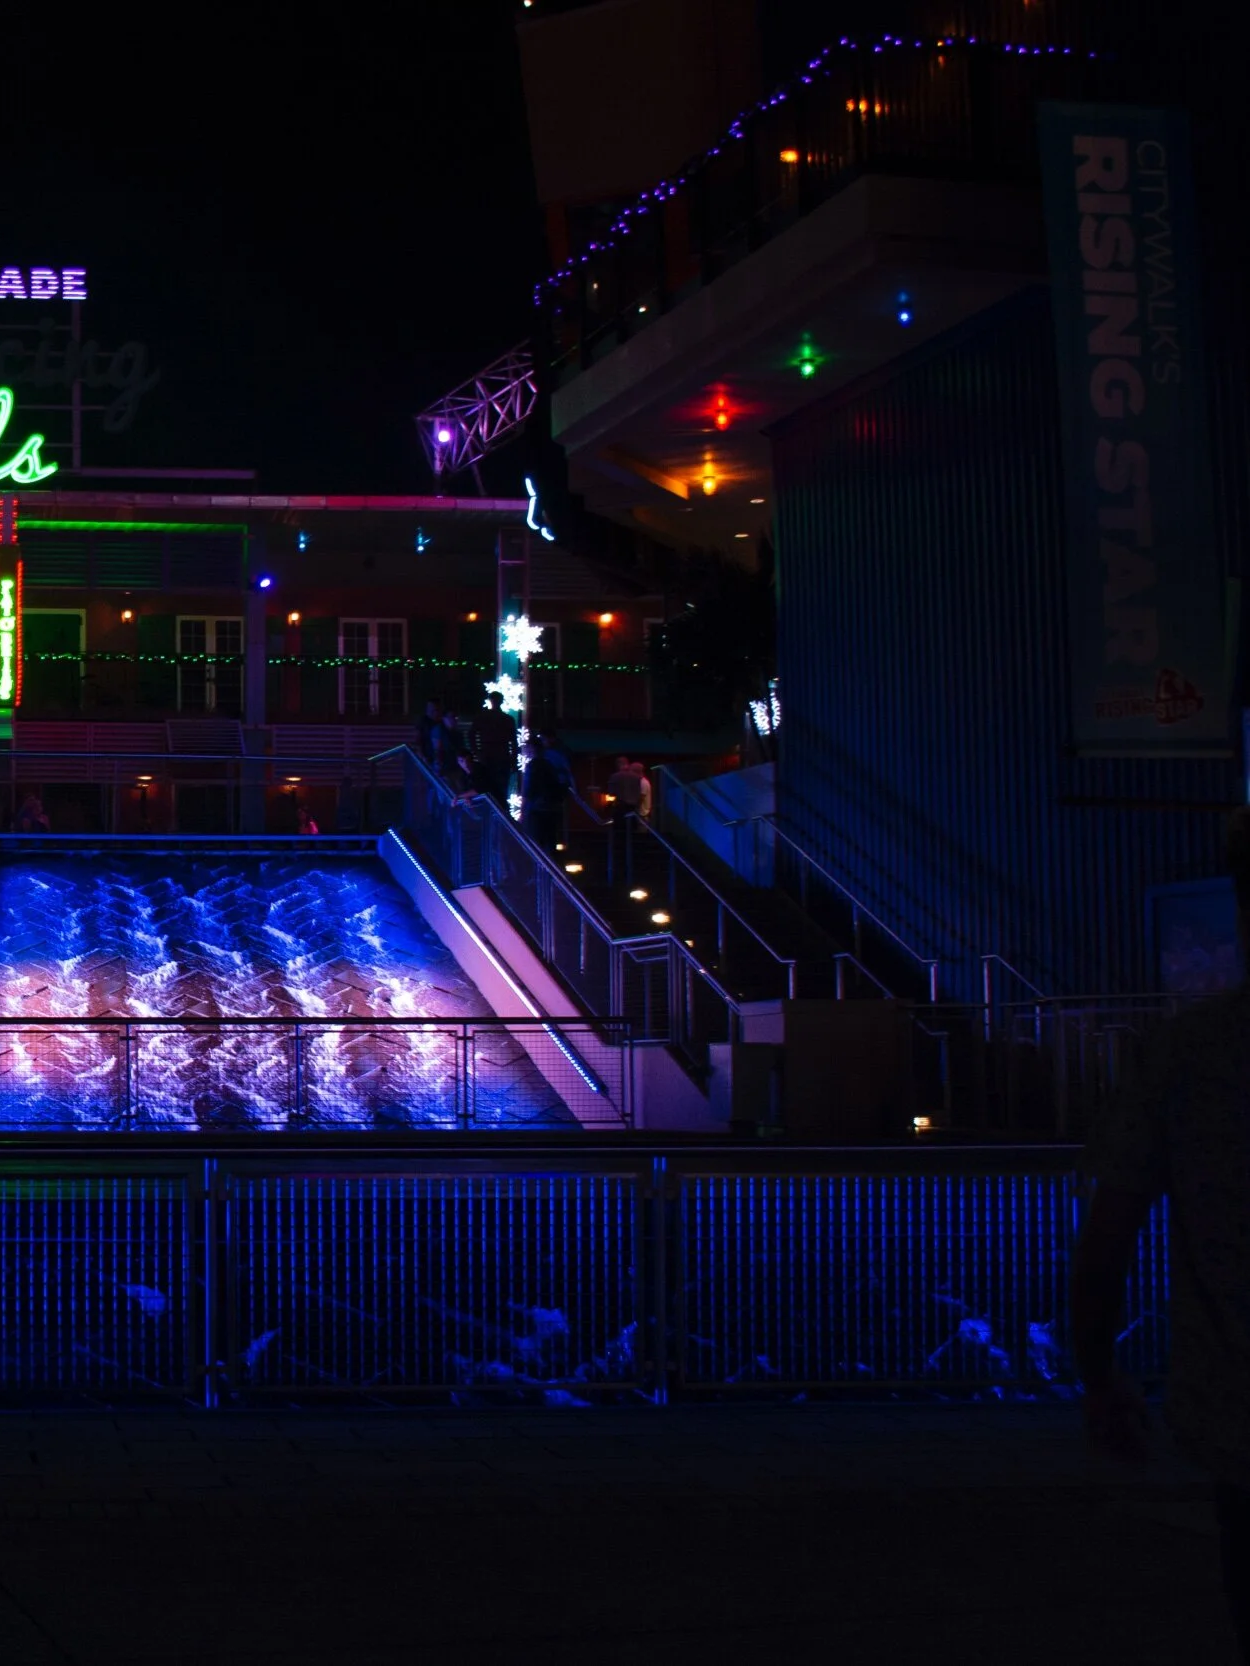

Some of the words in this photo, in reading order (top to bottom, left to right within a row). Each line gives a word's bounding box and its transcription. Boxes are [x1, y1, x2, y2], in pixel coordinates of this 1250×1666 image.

[1072, 134, 1147, 419] RISING
[1136, 139, 1181, 385] CITYWALK'S
[1094, 436, 1160, 667] STAR
